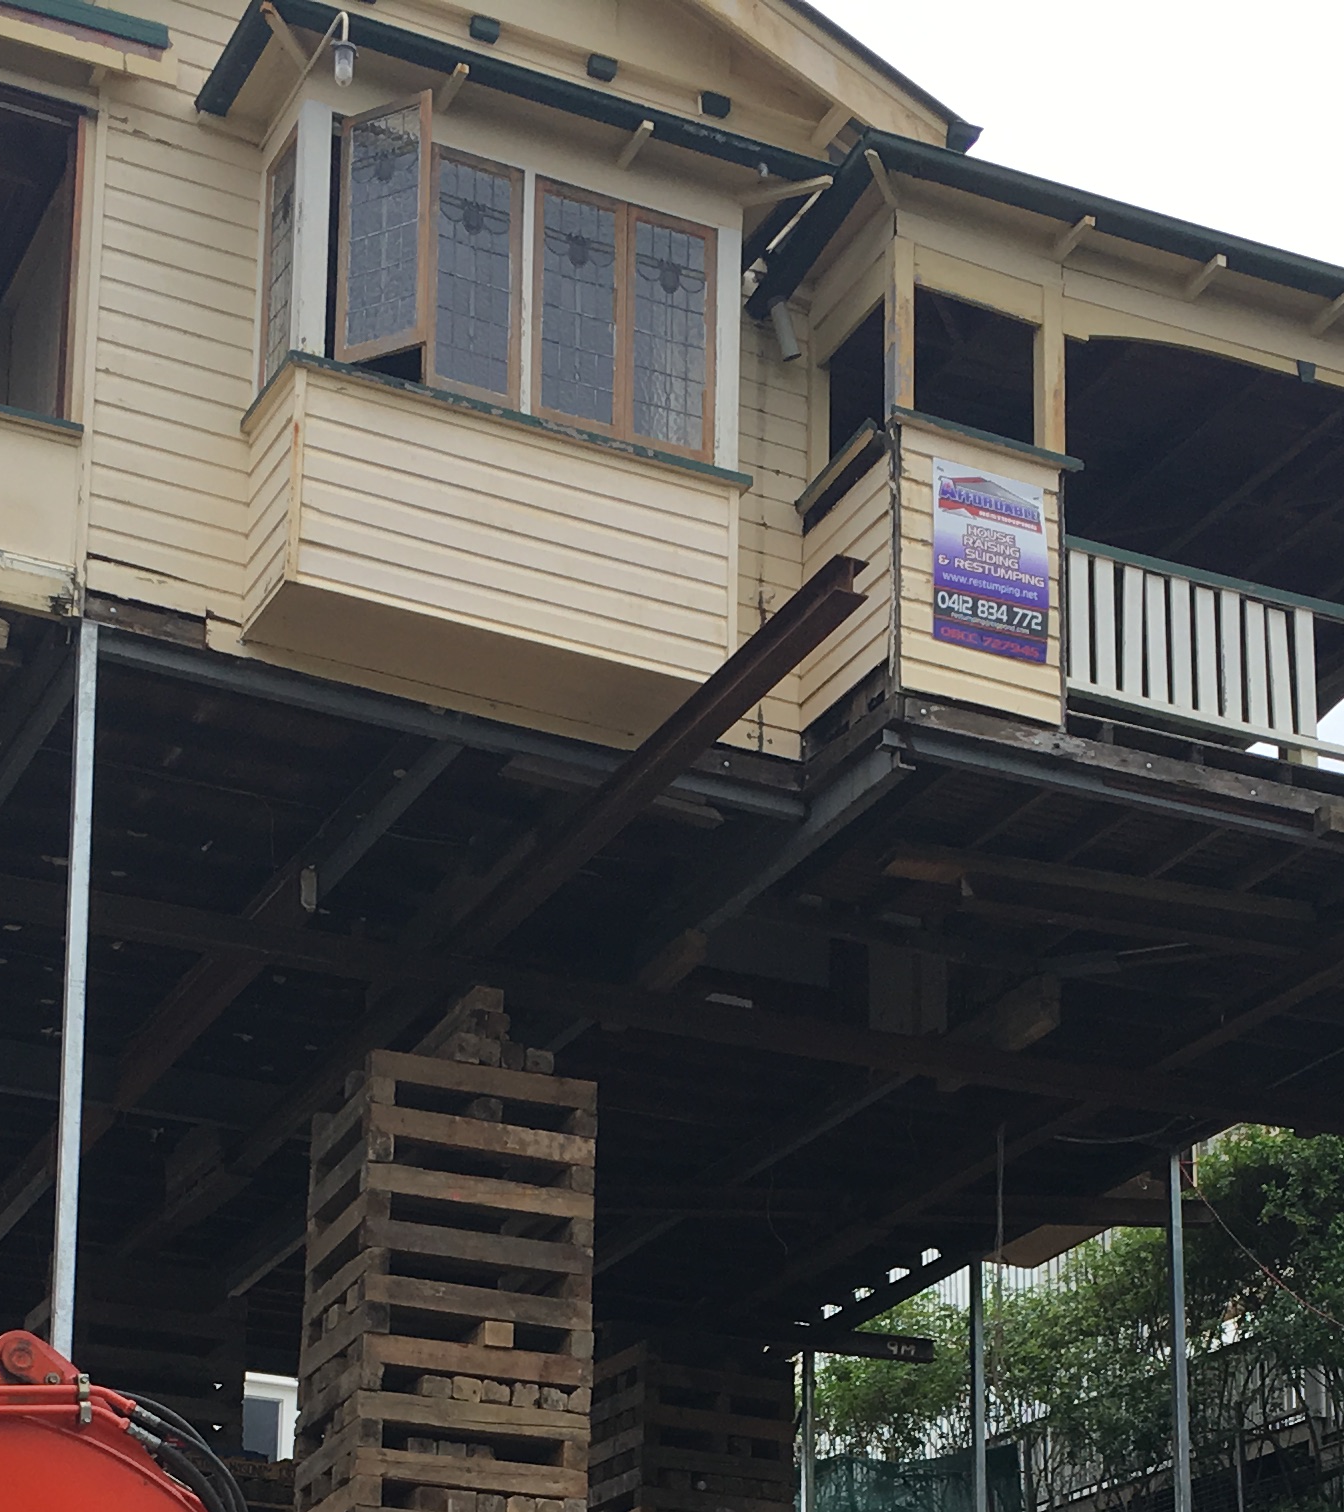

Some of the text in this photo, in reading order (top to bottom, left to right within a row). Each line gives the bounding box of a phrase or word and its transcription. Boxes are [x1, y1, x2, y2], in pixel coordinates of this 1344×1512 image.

[963, 535, 1020, 557] RAISING
[967, 524, 1015, 545] HOUSE
[938, 554, 1045, 588] & RESTUMPING
[965, 548, 1019, 569] SLIDING
[942, 572, 1038, 600] www.restumping.net
[937, 591, 973, 615] 0412
[977, 600, 1008, 622] 834
[1012, 607, 1042, 630] 772
